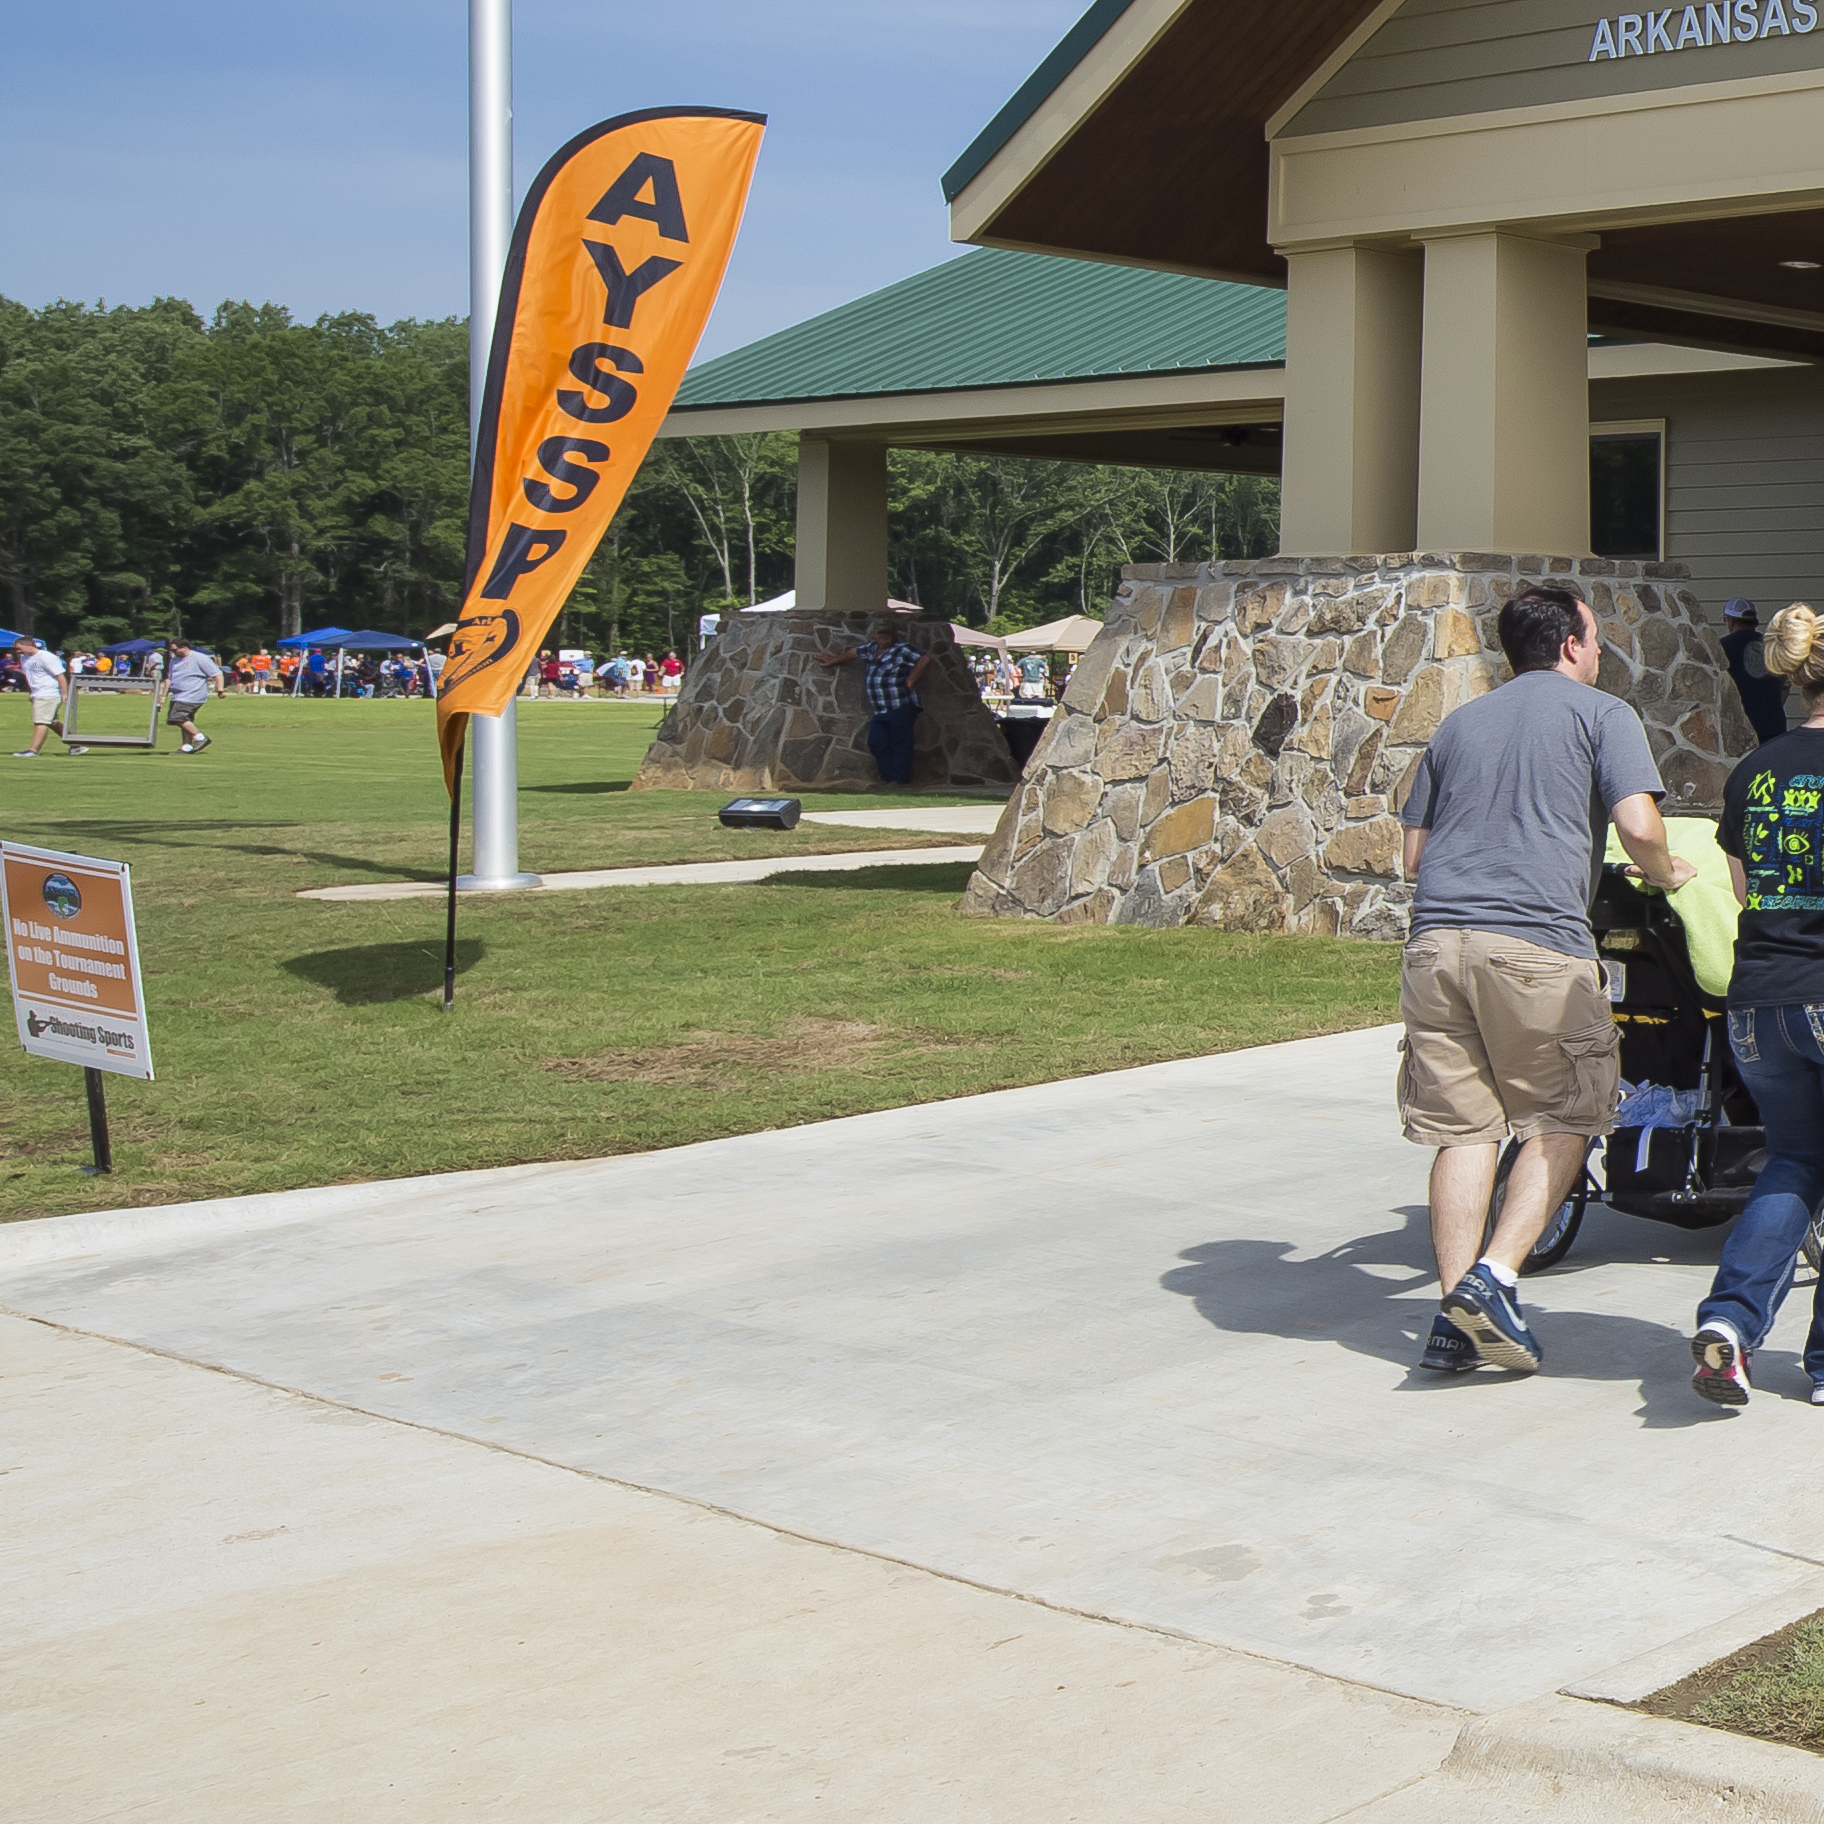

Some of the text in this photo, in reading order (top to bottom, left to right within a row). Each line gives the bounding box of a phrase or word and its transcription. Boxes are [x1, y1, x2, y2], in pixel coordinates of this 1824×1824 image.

[13, 918, 126, 956] No Live Ammunition
[18, 944, 127, 981] on the Tournament
[48, 972, 99, 999] Grounds
[50, 1015, 97, 1044] Shooting
[97, 1025, 135, 1050] Sports
